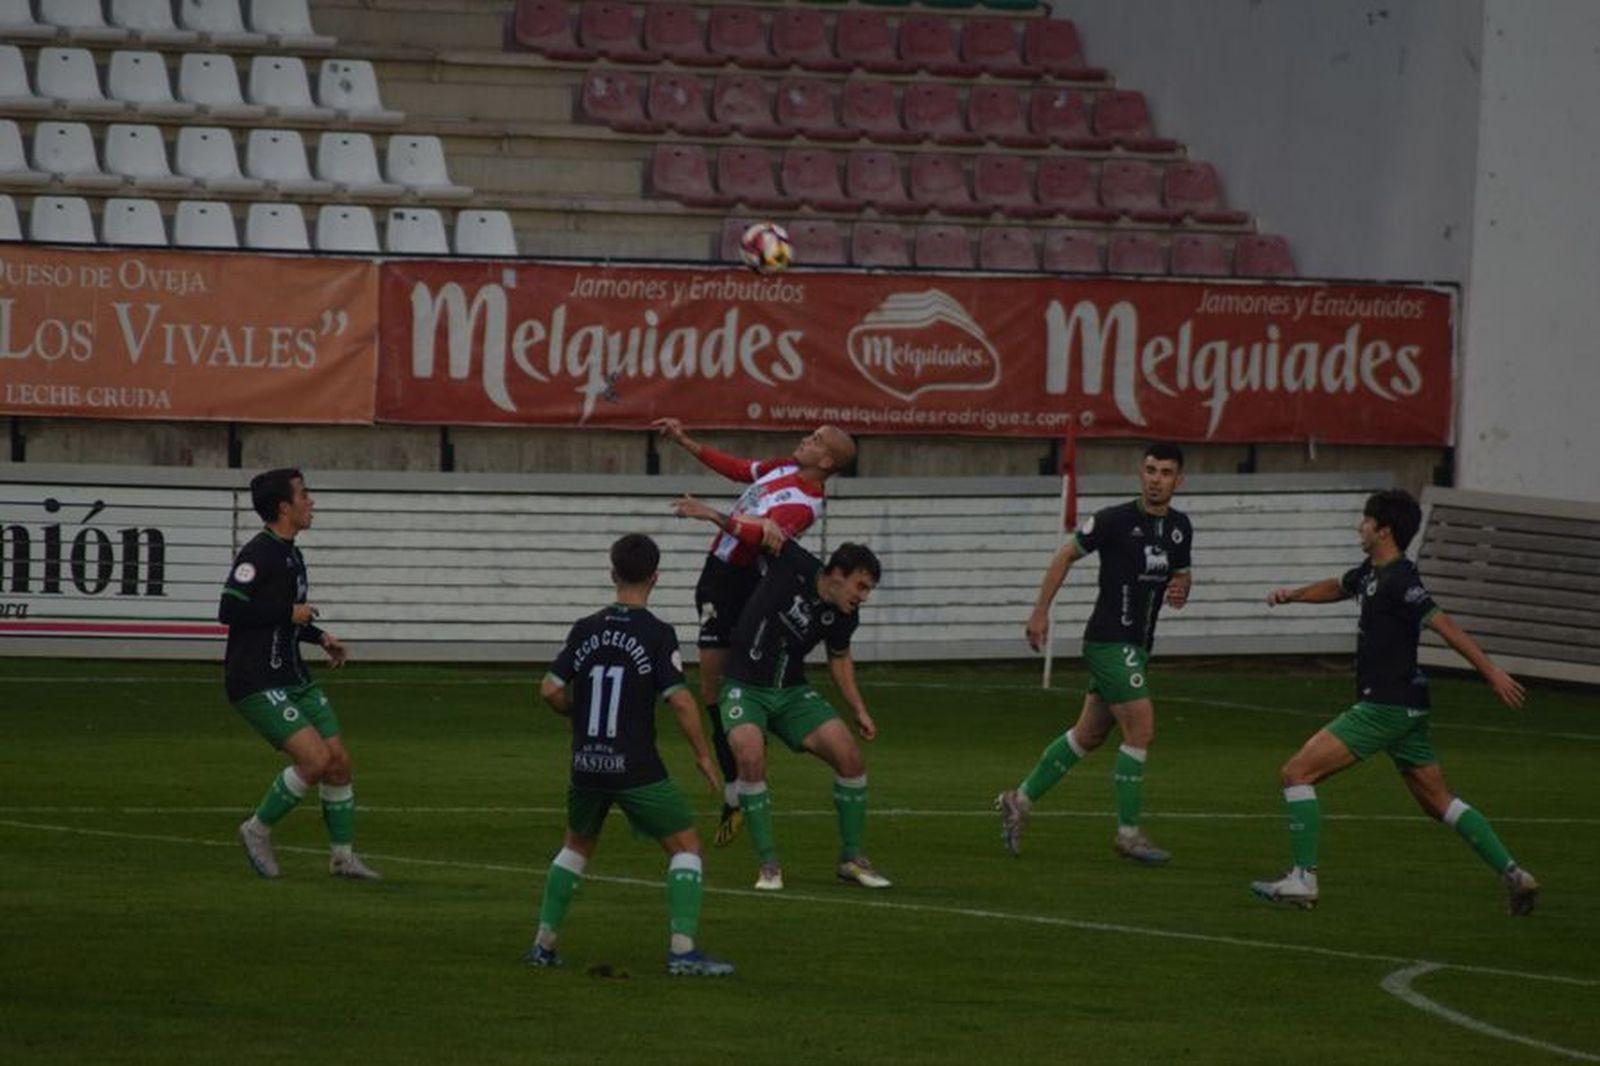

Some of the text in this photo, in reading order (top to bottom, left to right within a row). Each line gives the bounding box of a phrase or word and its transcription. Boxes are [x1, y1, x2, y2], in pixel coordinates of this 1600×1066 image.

[0, 258, 72, 288] UESO
[569, 272, 805, 307] Jamones y Embutidos
[1196, 288, 1426, 322] Jamones y Embutidos
[410, 280, 805, 426] Melquiades
[1044, 299, 1423, 439] Melquiades
[5, 384, 172, 410] LECHE CRUDA
[1122, 646, 1139, 667] 2
[587, 664, 625, 738] 11
